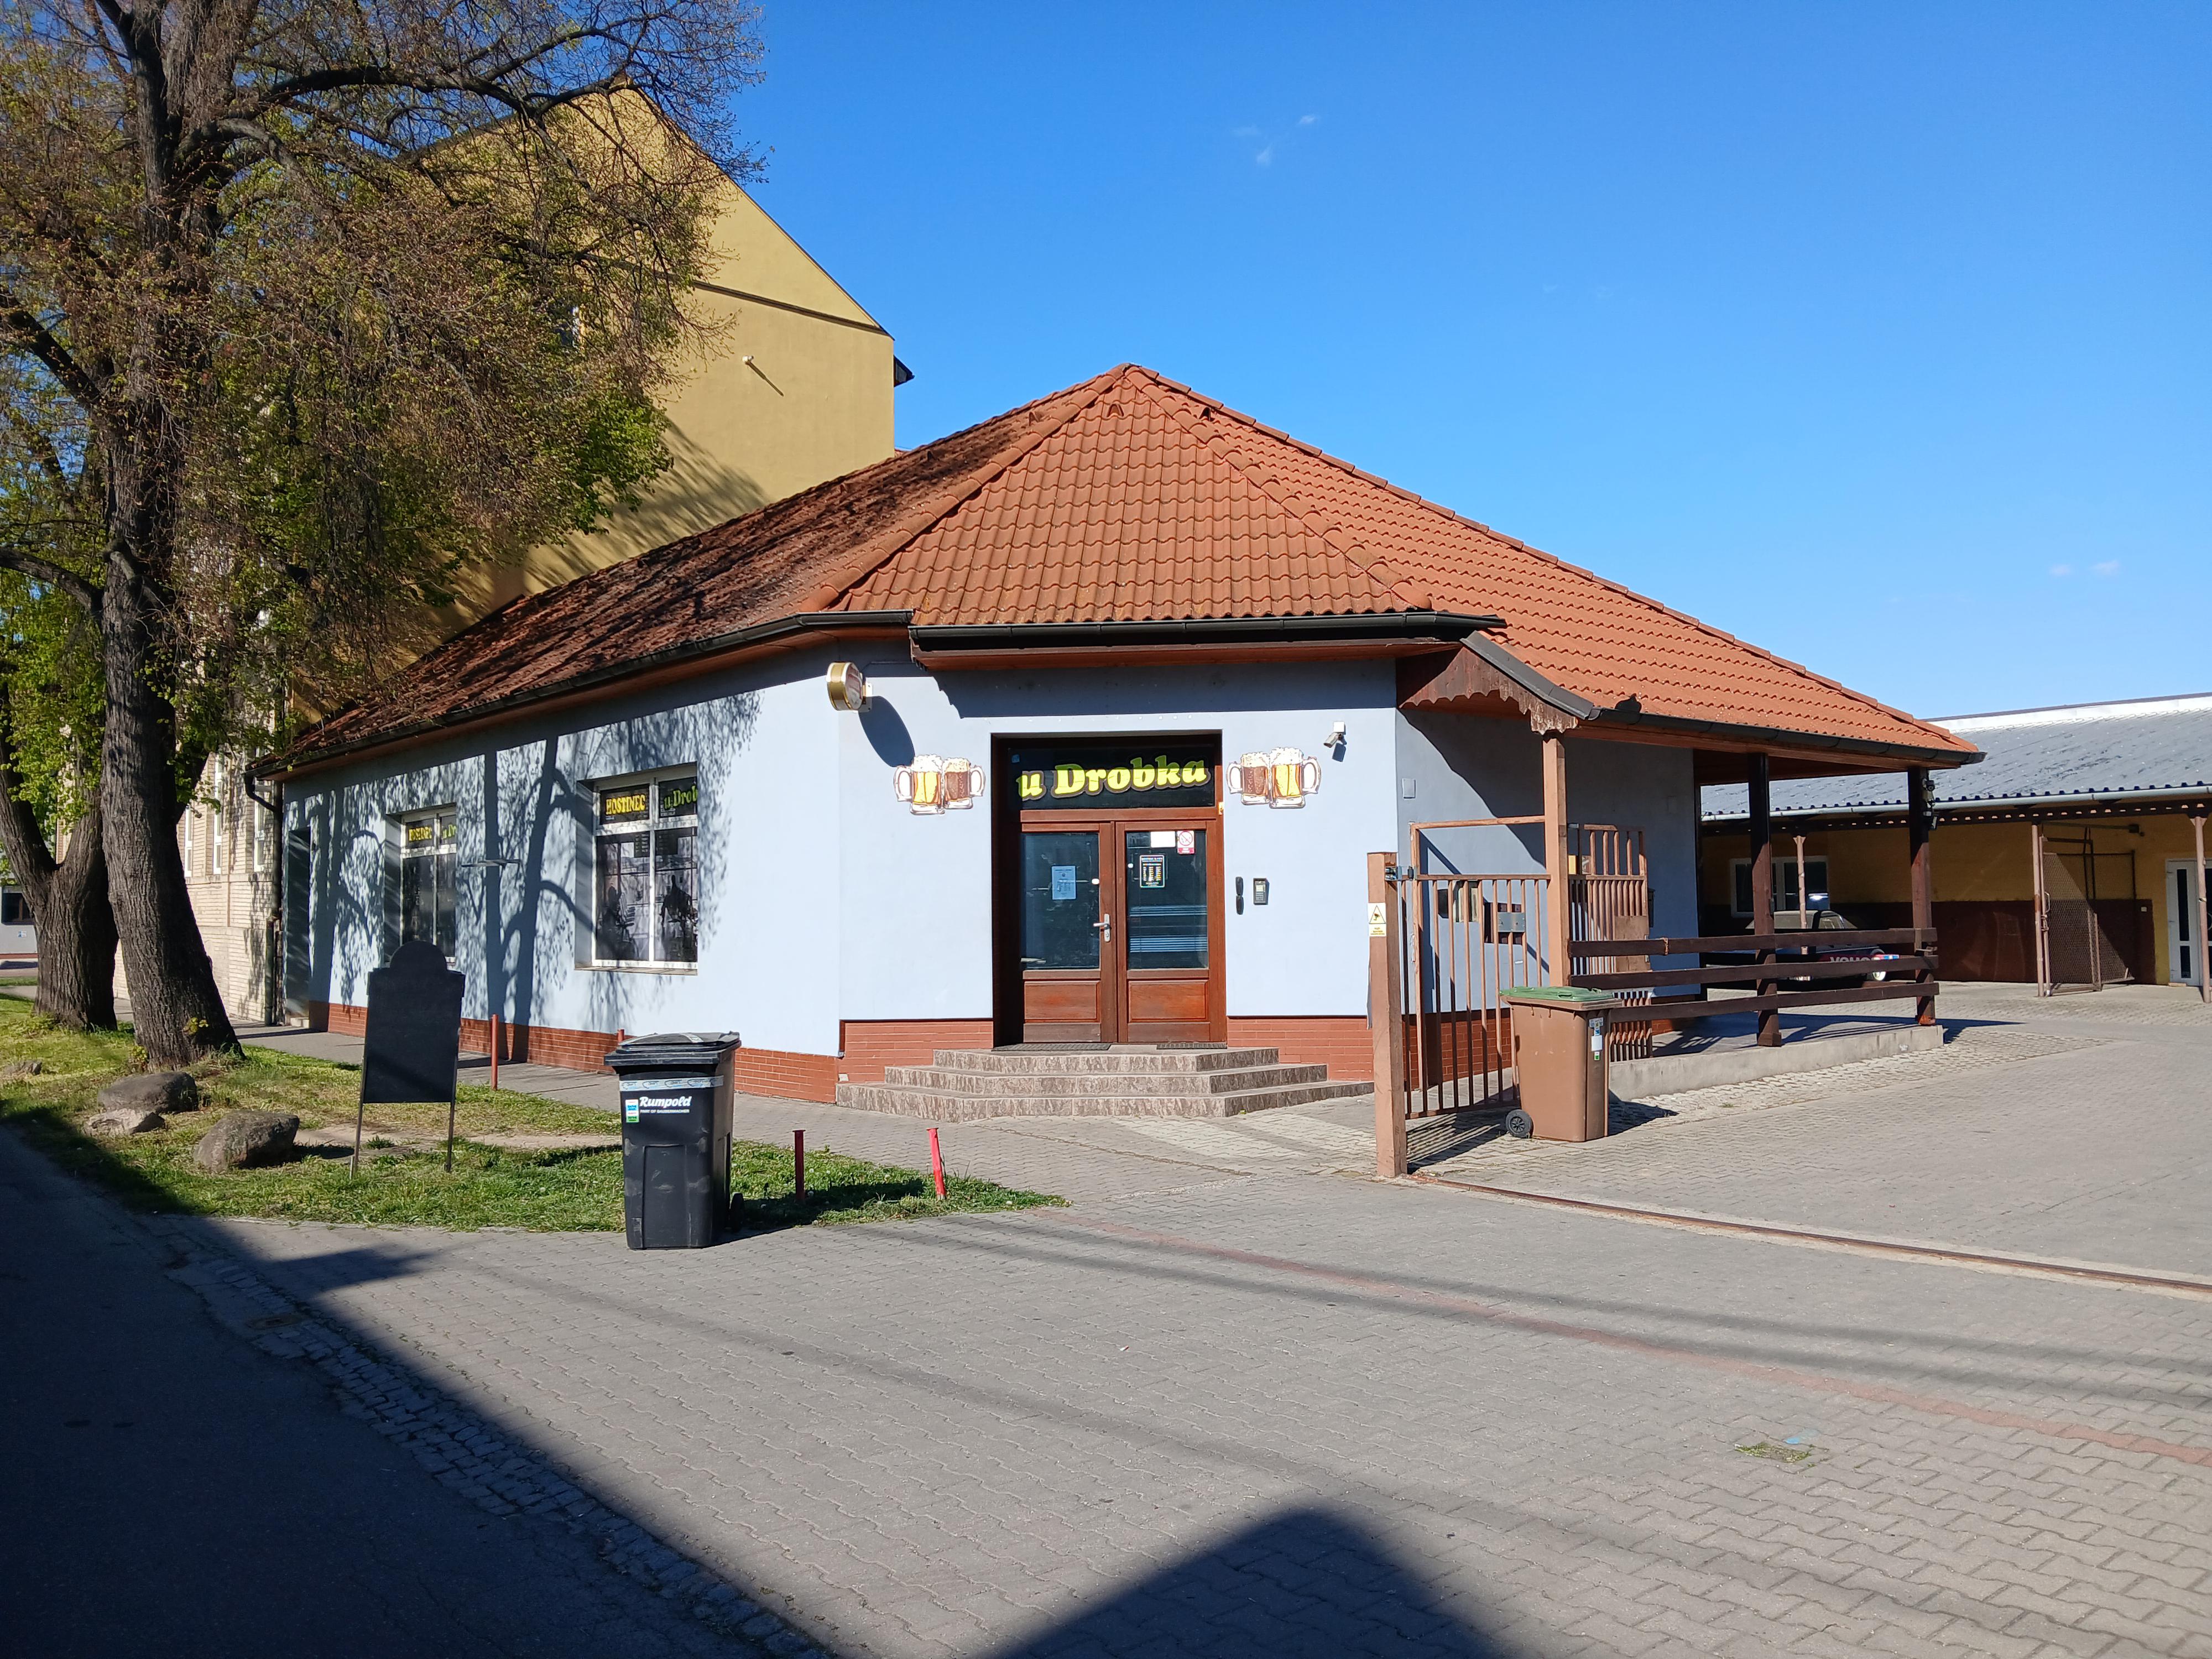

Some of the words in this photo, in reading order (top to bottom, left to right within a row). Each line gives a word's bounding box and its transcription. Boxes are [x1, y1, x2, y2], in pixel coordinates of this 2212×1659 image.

[1016, 773, 1043, 797] u
[1054, 755, 1207, 795] Drobka
[606, 794, 646, 815] HOSTINEC
[664, 796, 671, 809] u
[639, 1096, 692, 1108] Rumpold
